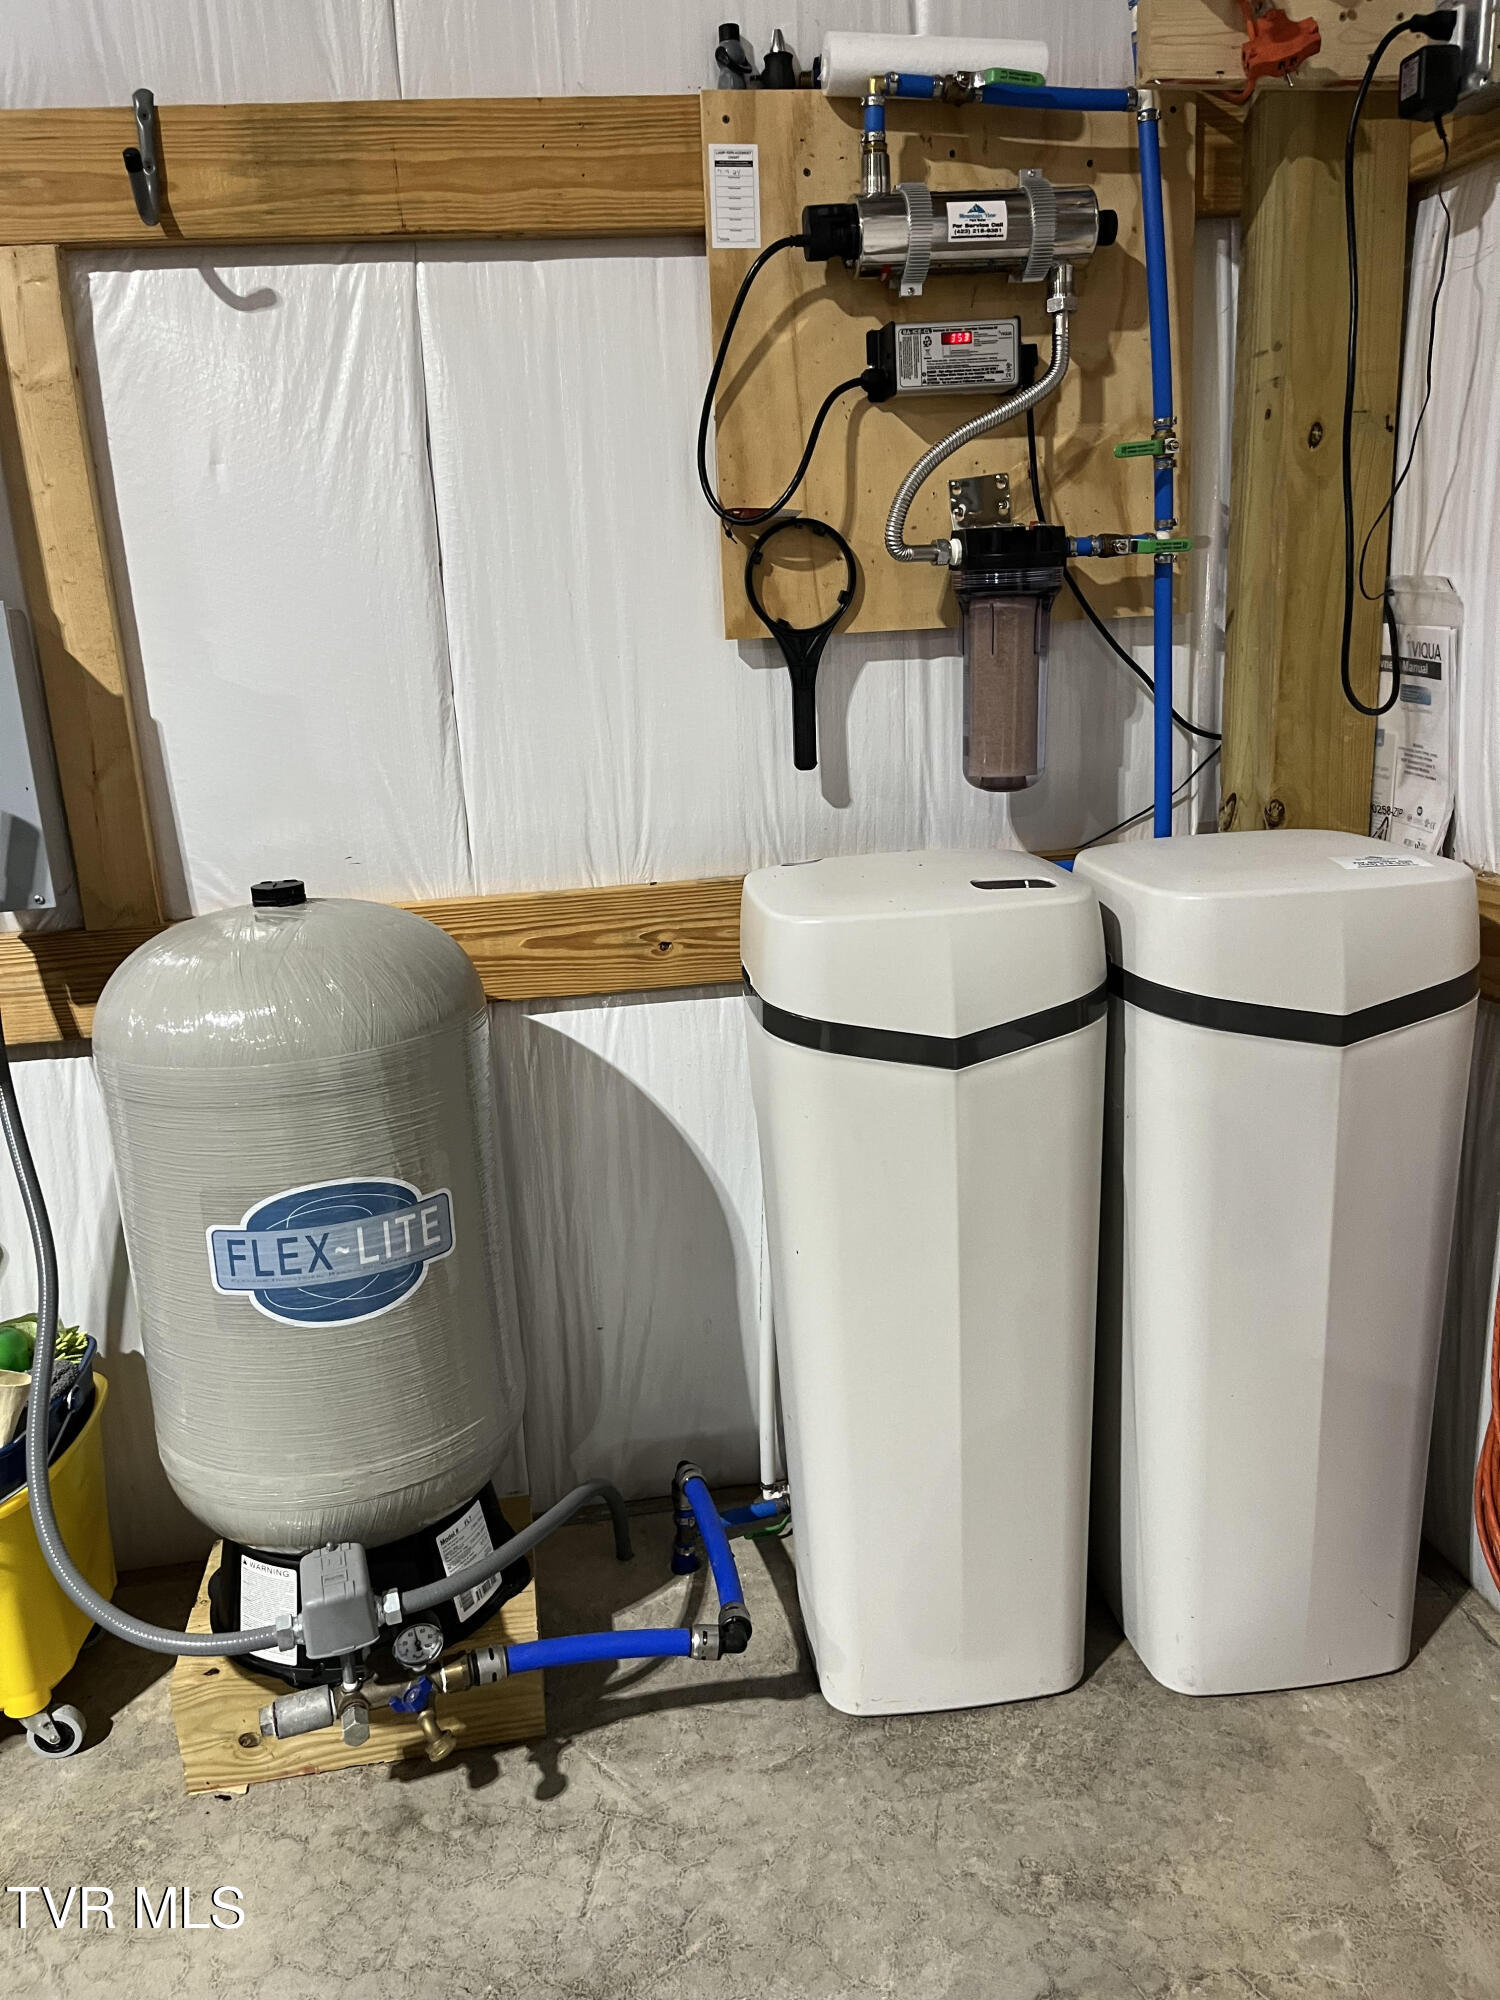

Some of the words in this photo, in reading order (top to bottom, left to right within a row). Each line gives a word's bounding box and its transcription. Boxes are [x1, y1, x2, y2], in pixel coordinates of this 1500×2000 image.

[1411, 640, 1442, 661] VIQUA
[1401, 660, 1429, 675] Manual
[249, 1560, 290, 1578] WARNING
